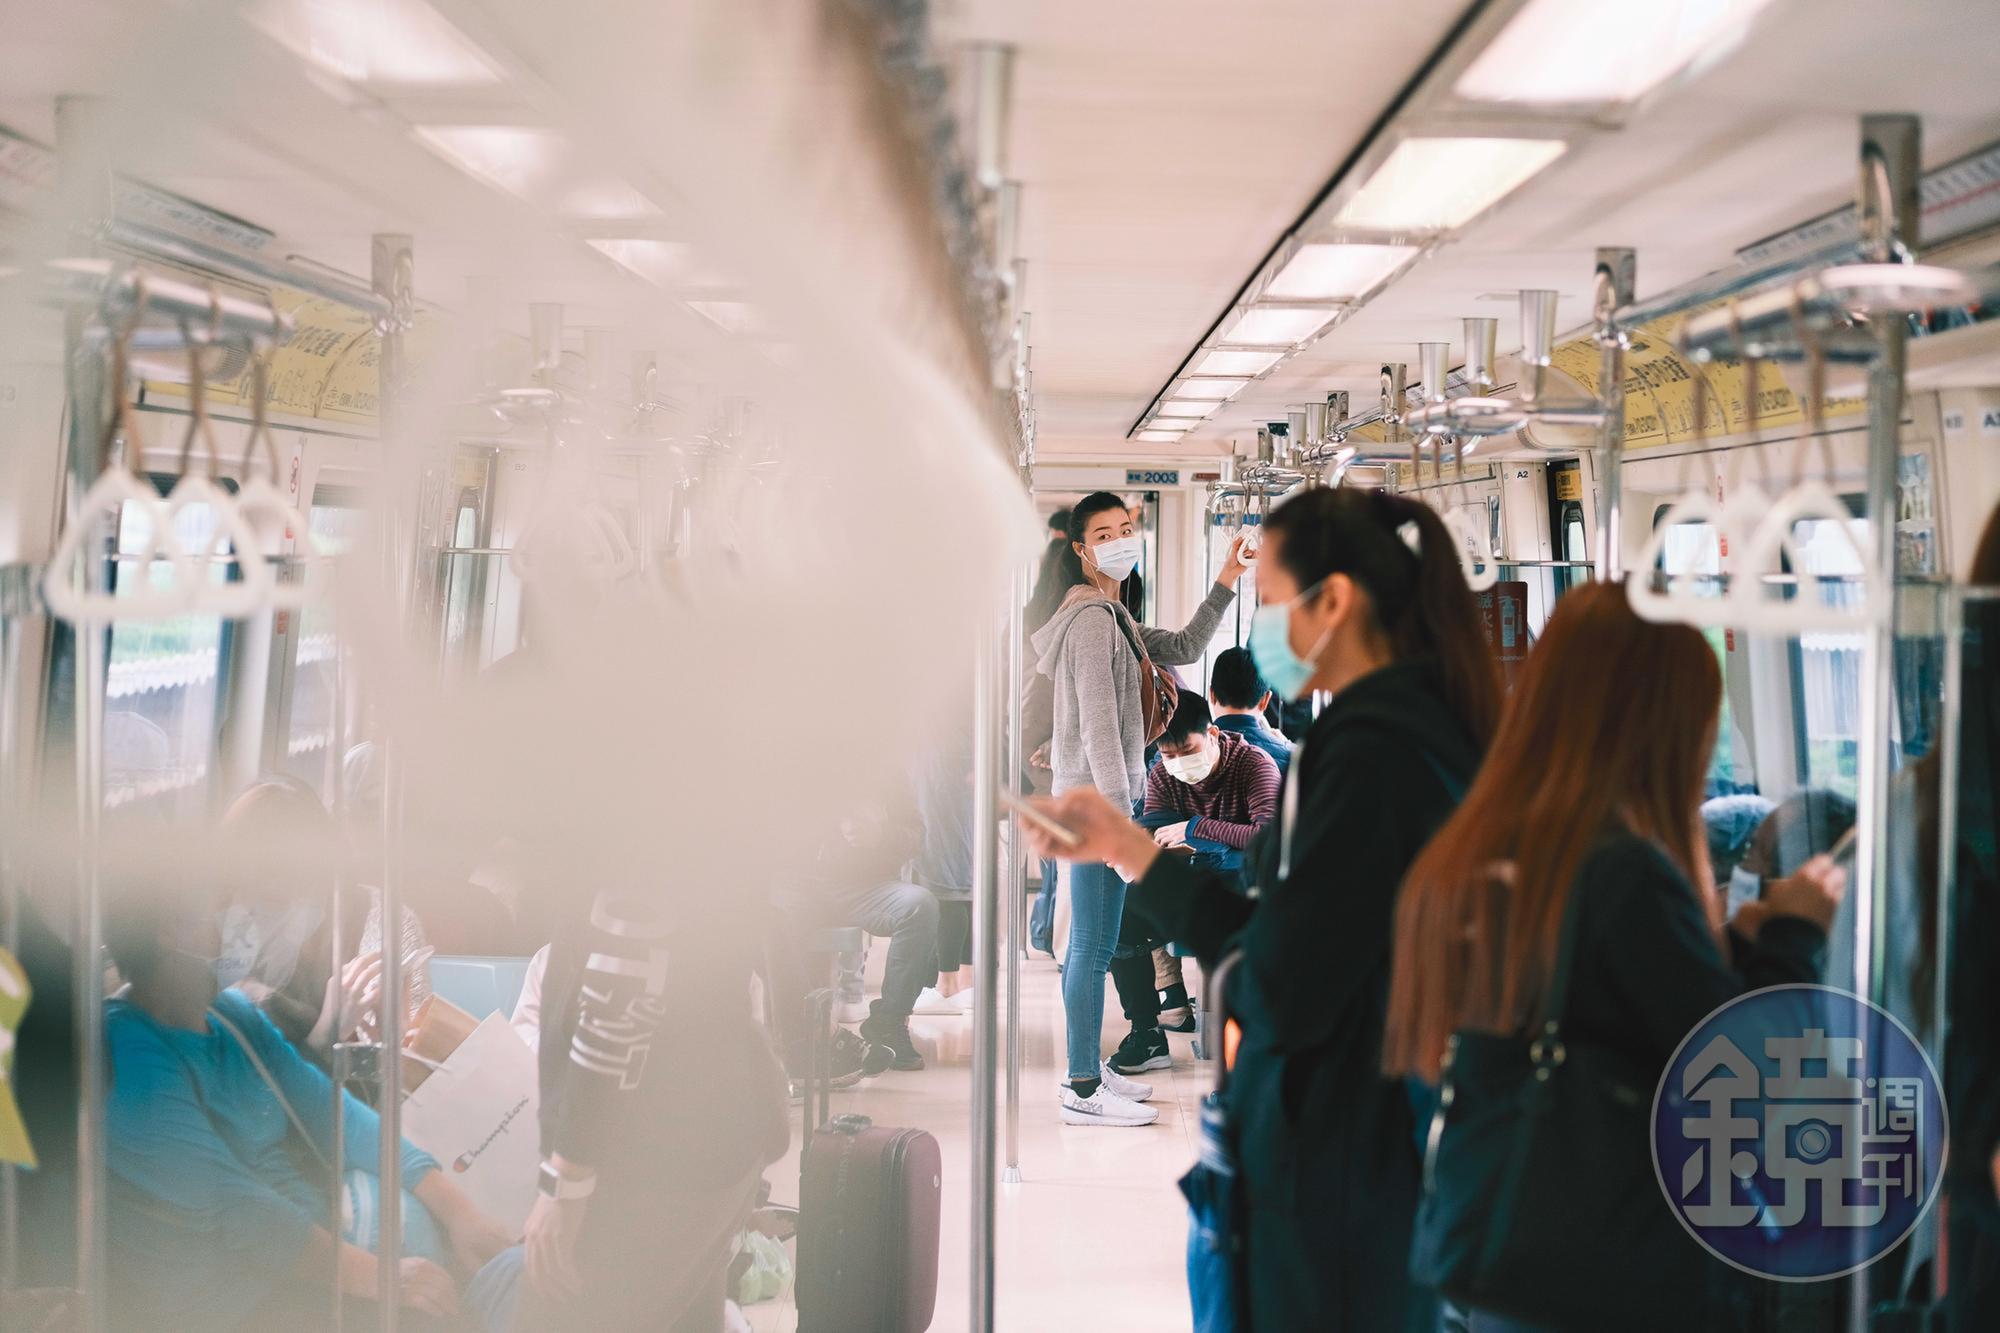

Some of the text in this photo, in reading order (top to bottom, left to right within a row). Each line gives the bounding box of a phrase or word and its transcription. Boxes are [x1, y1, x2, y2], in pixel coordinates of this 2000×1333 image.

[1983, 411, 2000, 428] A
[1144, 472, 1177, 484] 2003
[1516, 471, 1529, 479] A2
[1072, 1099, 1103, 1114] HOKA
[453, 1095, 529, 1174] Champion
